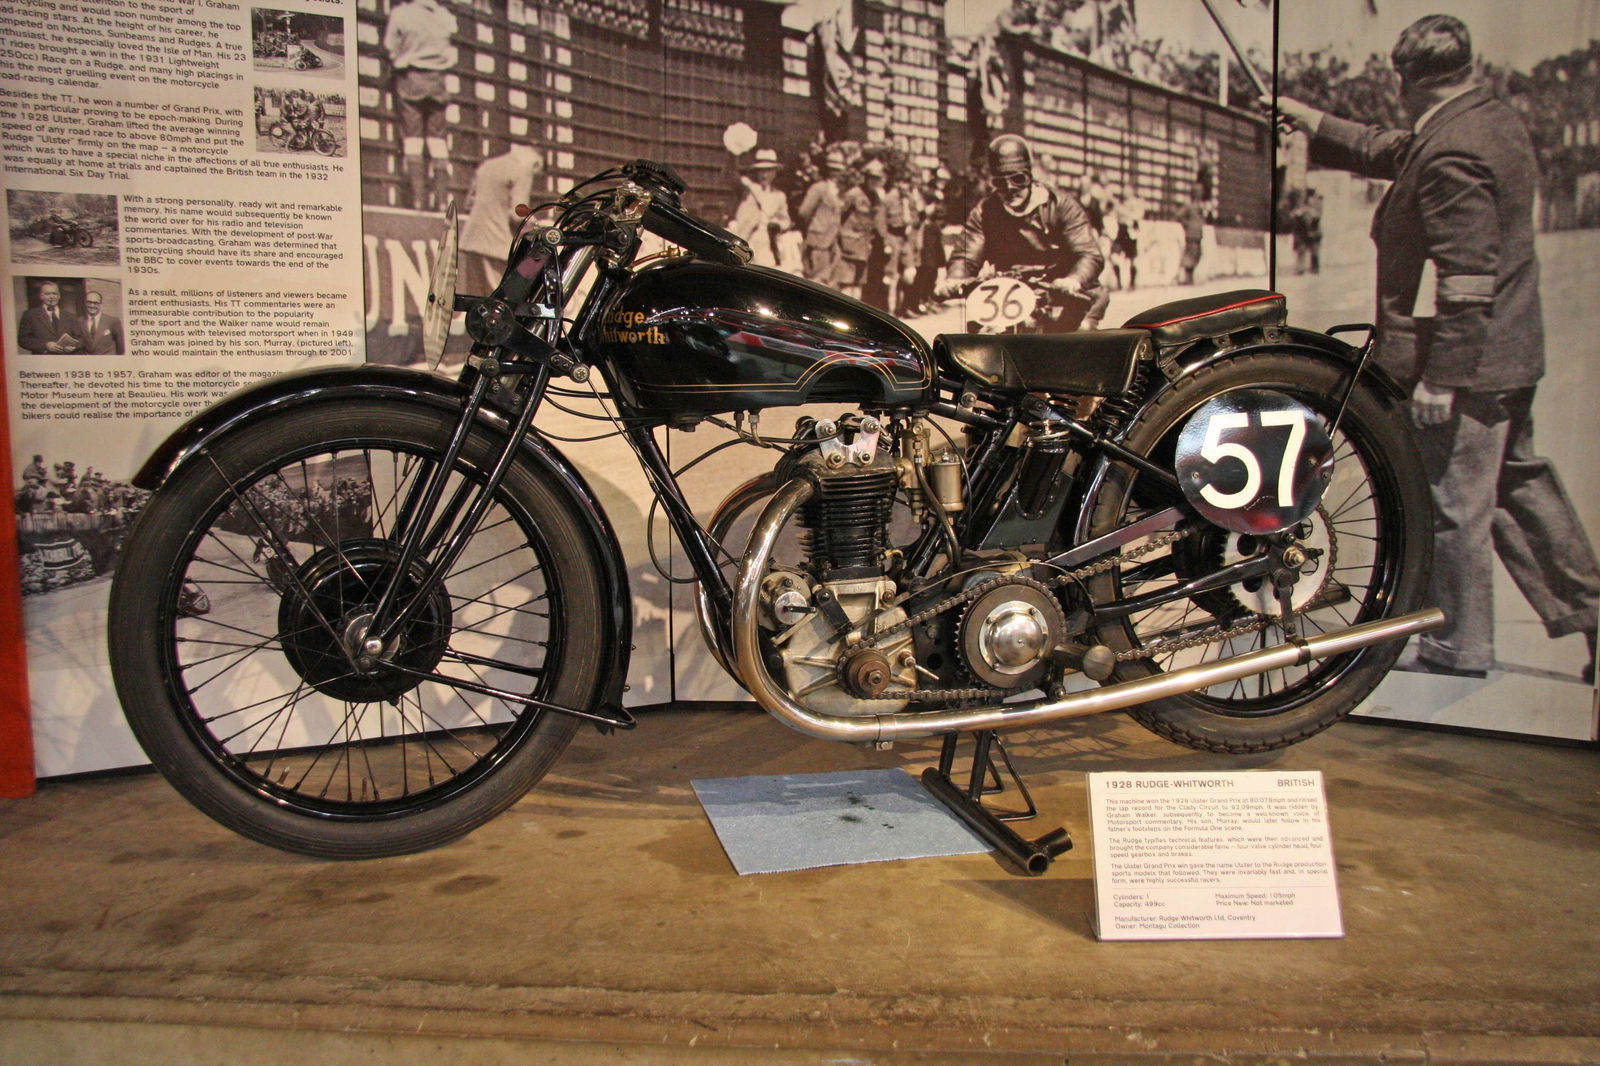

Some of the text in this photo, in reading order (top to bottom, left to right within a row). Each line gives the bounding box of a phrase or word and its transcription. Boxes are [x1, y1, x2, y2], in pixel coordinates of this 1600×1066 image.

[979, 284, 1023, 321] 36
[1199, 410, 1306, 509] 57
[1106, 779, 1233, 789] 1928 RUDGE-WHITWORTH
[1277, 779, 1314, 787] BRITISH
